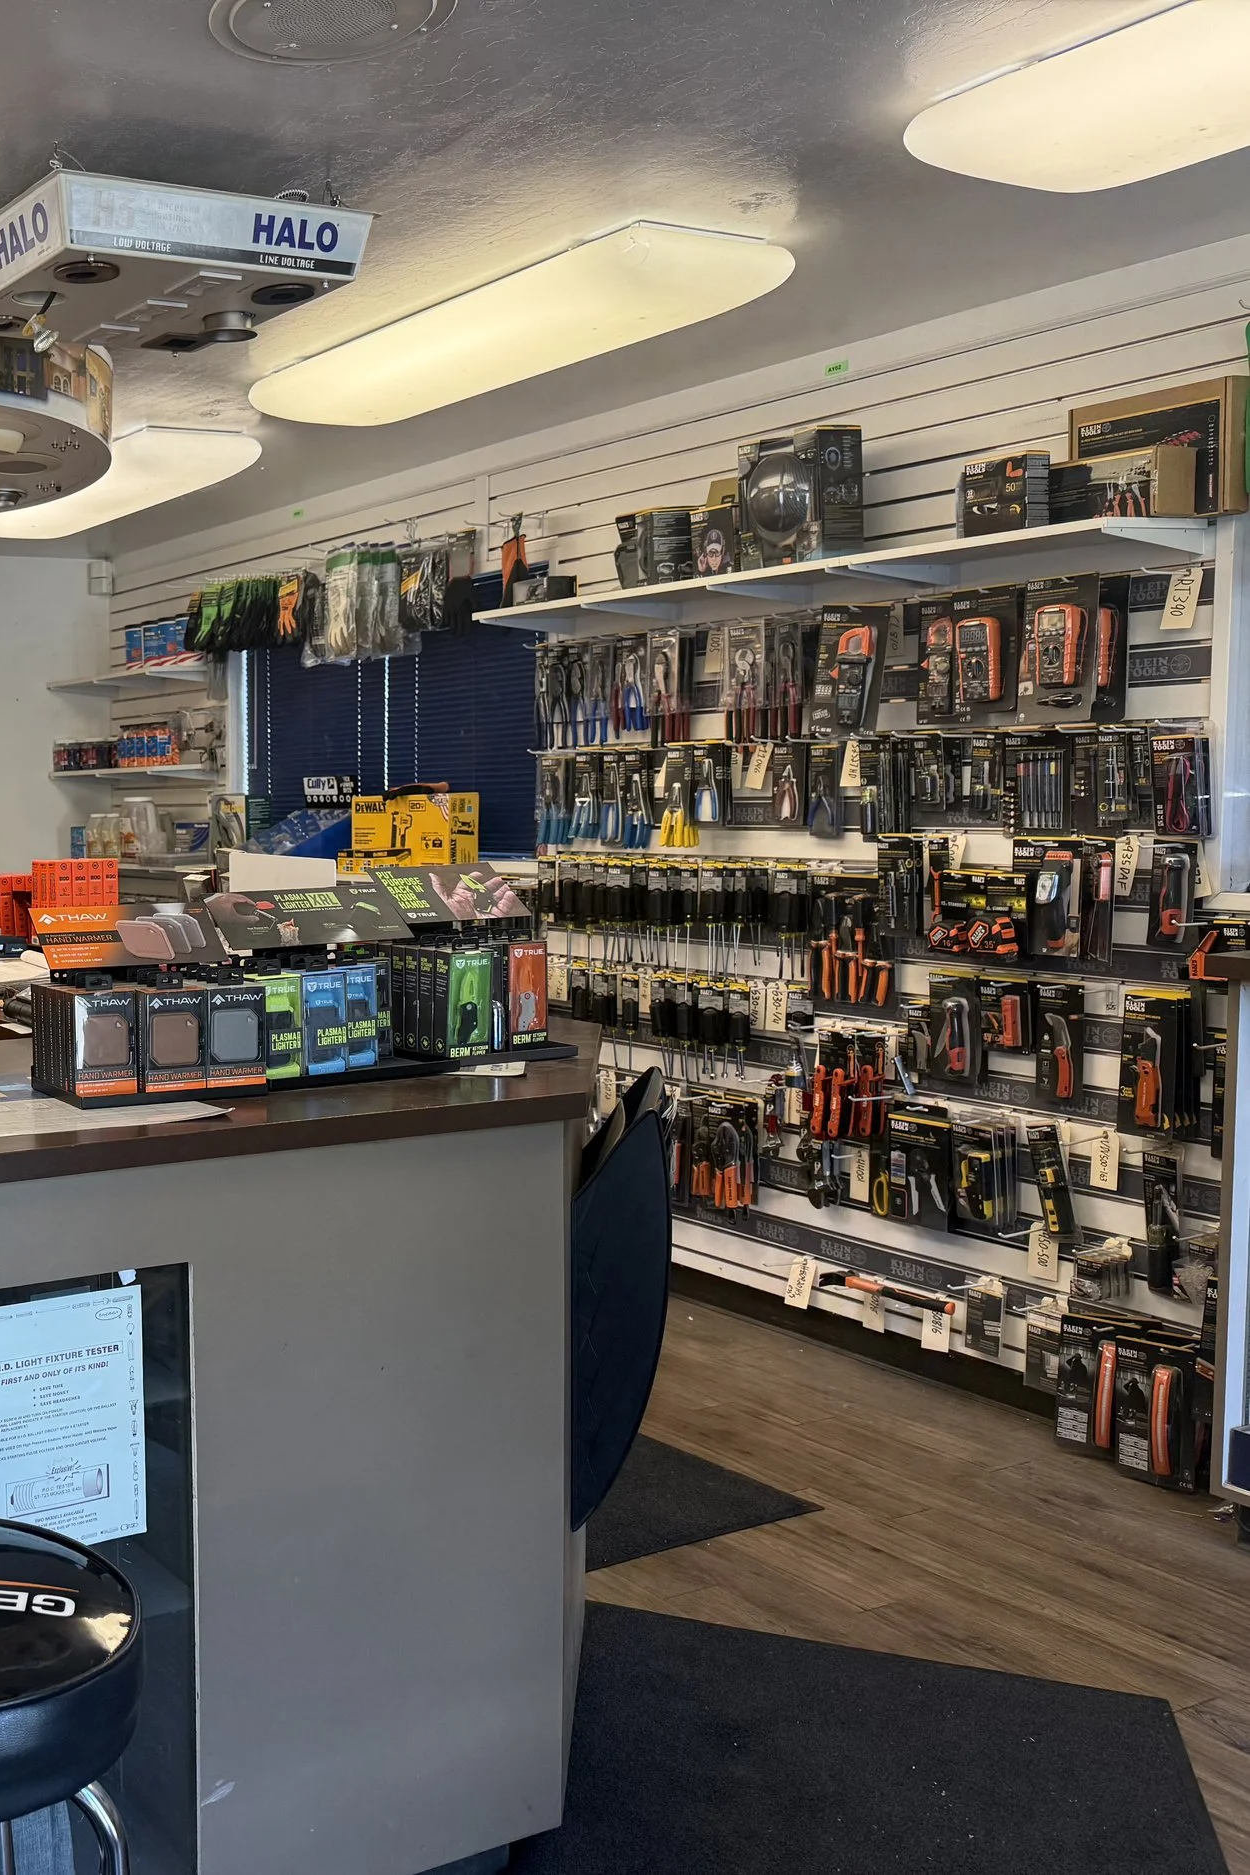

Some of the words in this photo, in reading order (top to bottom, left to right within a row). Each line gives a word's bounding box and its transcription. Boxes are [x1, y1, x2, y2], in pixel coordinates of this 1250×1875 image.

[252, 213, 338, 253] HALO
[113, 237, 133, 248] LOW
[136, 240, 171, 252] VOLTAGE
[259, 254, 278, 266] LINE
[281, 256, 315, 269] VOLTAGE
[1080, 424, 1101, 432] KLEIN
[966, 463, 986, 471] KLEIN
[966, 468, 986, 476] TOOLS
[1005, 483, 1016, 492] 50
[1170, 578, 1195, 617] RT390
[1116, 845, 1134, 892] 935DAF
[376, 871, 393, 879] PUT
[381, 877, 423, 886] PURPOSE
[386, 884, 413, 893] BACK
[414, 884, 424, 892] IN
[273, 894, 306, 902] PLASMA
[308, 892, 340, 907] XRL
[393, 893, 418, 901] YOUR
[279, 901, 311, 910] LIGHTER
[398, 900, 430, 909] HANDS
[56, 913, 107, 922] THAW
[46, 935, 72, 944] HAND
[74, 934, 113, 943] WARMER
[271, 985, 296, 993] TRUE
[318, 981, 342, 989] TRUE
[164, 996, 202, 1006] THAW
[225, 993, 263, 1002] THAW
[92, 998, 131, 1008] THAW
[348, 1020, 371, 1030] PLASMA
[272, 1031, 297, 1042] PLASMA
[318, 1027, 343, 1037] PLASMA
[348, 1028, 372, 1039] LIGHTER
[318, 1036, 343, 1046] LIGHTER
[513, 1034, 531, 1045] BERM
[272, 1041, 297, 1051] LIGHTER
[450, 1047, 470, 1058] BERM
[78, 1072, 100, 1081] HAND
[100, 1070, 133, 1080] WARMER
[149, 1073, 170, 1082] HAND
[171, 1071, 203, 1080] WARMER
[209, 1069, 231, 1077] HAND
[231, 1066, 263, 1075] WARMER
[820, 1238, 851, 1254] KLEIN
[821, 1247, 850, 1262] TOOLS
[890, 1258, 925, 1273] KLEIN
[890, 1266, 924, 1281] TOOLS
[15, 1357, 42, 1369] LIGHT
[45, 1351, 83, 1364] FIXTURE
[86, 1344, 120, 1357] TESTER
[1, 1376, 22, 1386] FIRST
[24, 1372, 40, 1382] AND
[42, 1370, 61, 1379] ONLY
[63, 1367, 73, 1376] OF
[74, 1365, 86, 1374] ITS
[88, 1361, 109, 1371] KIND!
